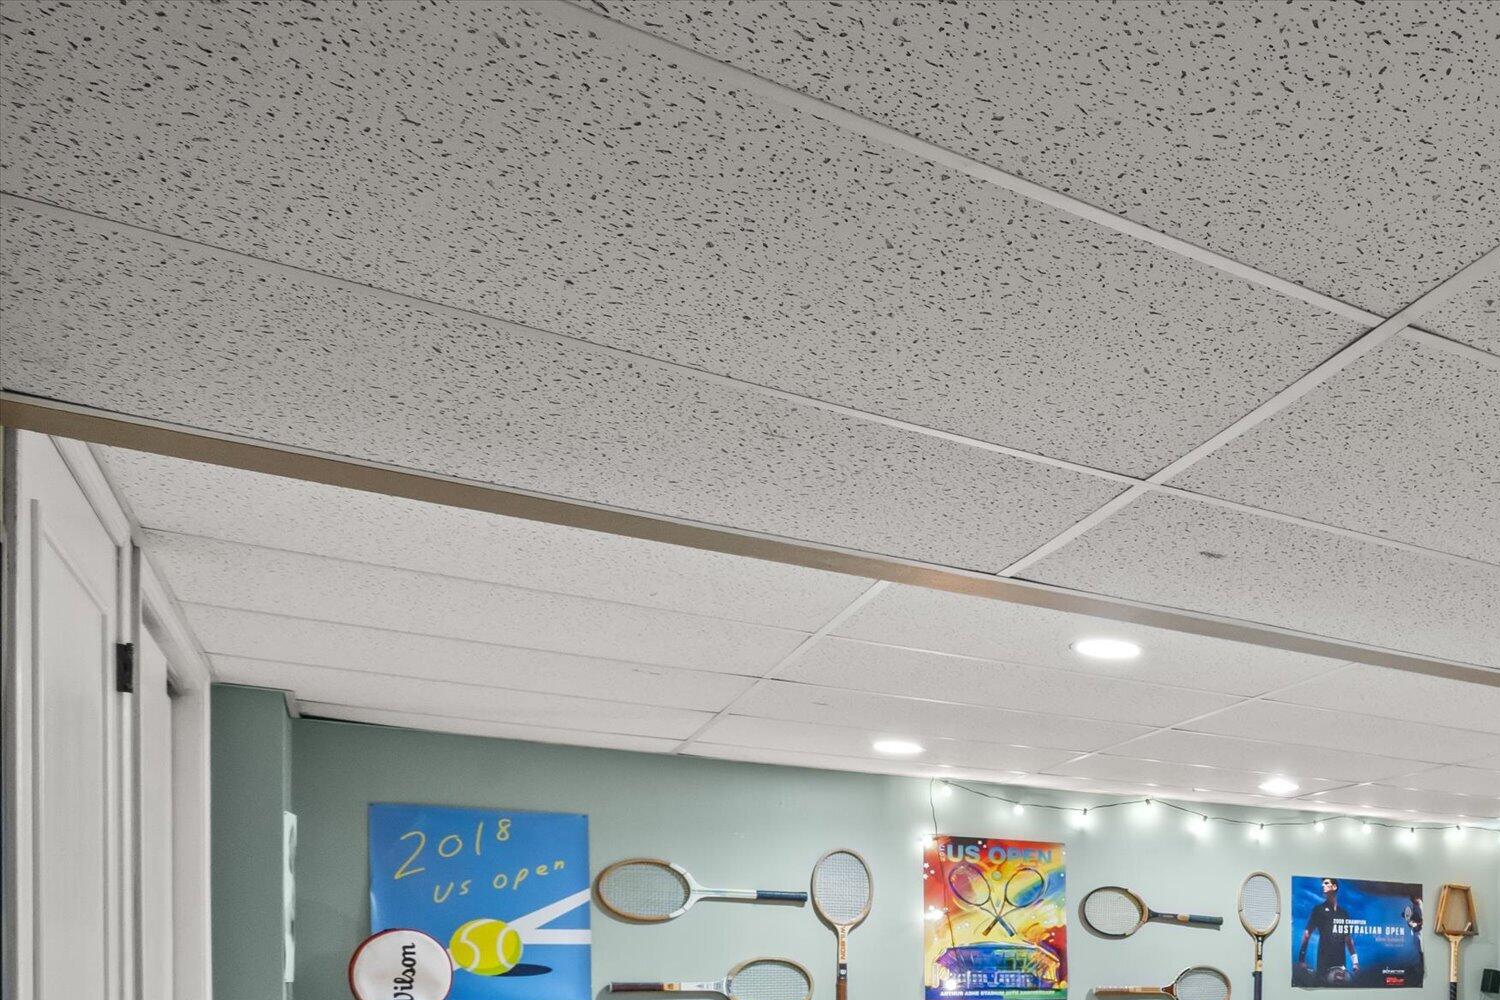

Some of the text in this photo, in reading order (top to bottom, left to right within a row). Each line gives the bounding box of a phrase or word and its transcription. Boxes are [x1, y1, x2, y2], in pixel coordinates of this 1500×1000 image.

[395, 819, 512, 879] 2018
[946, 844, 1052, 864] US OPEN
[1332, 924, 1405, 935] AUSTRALIAN OPEN
